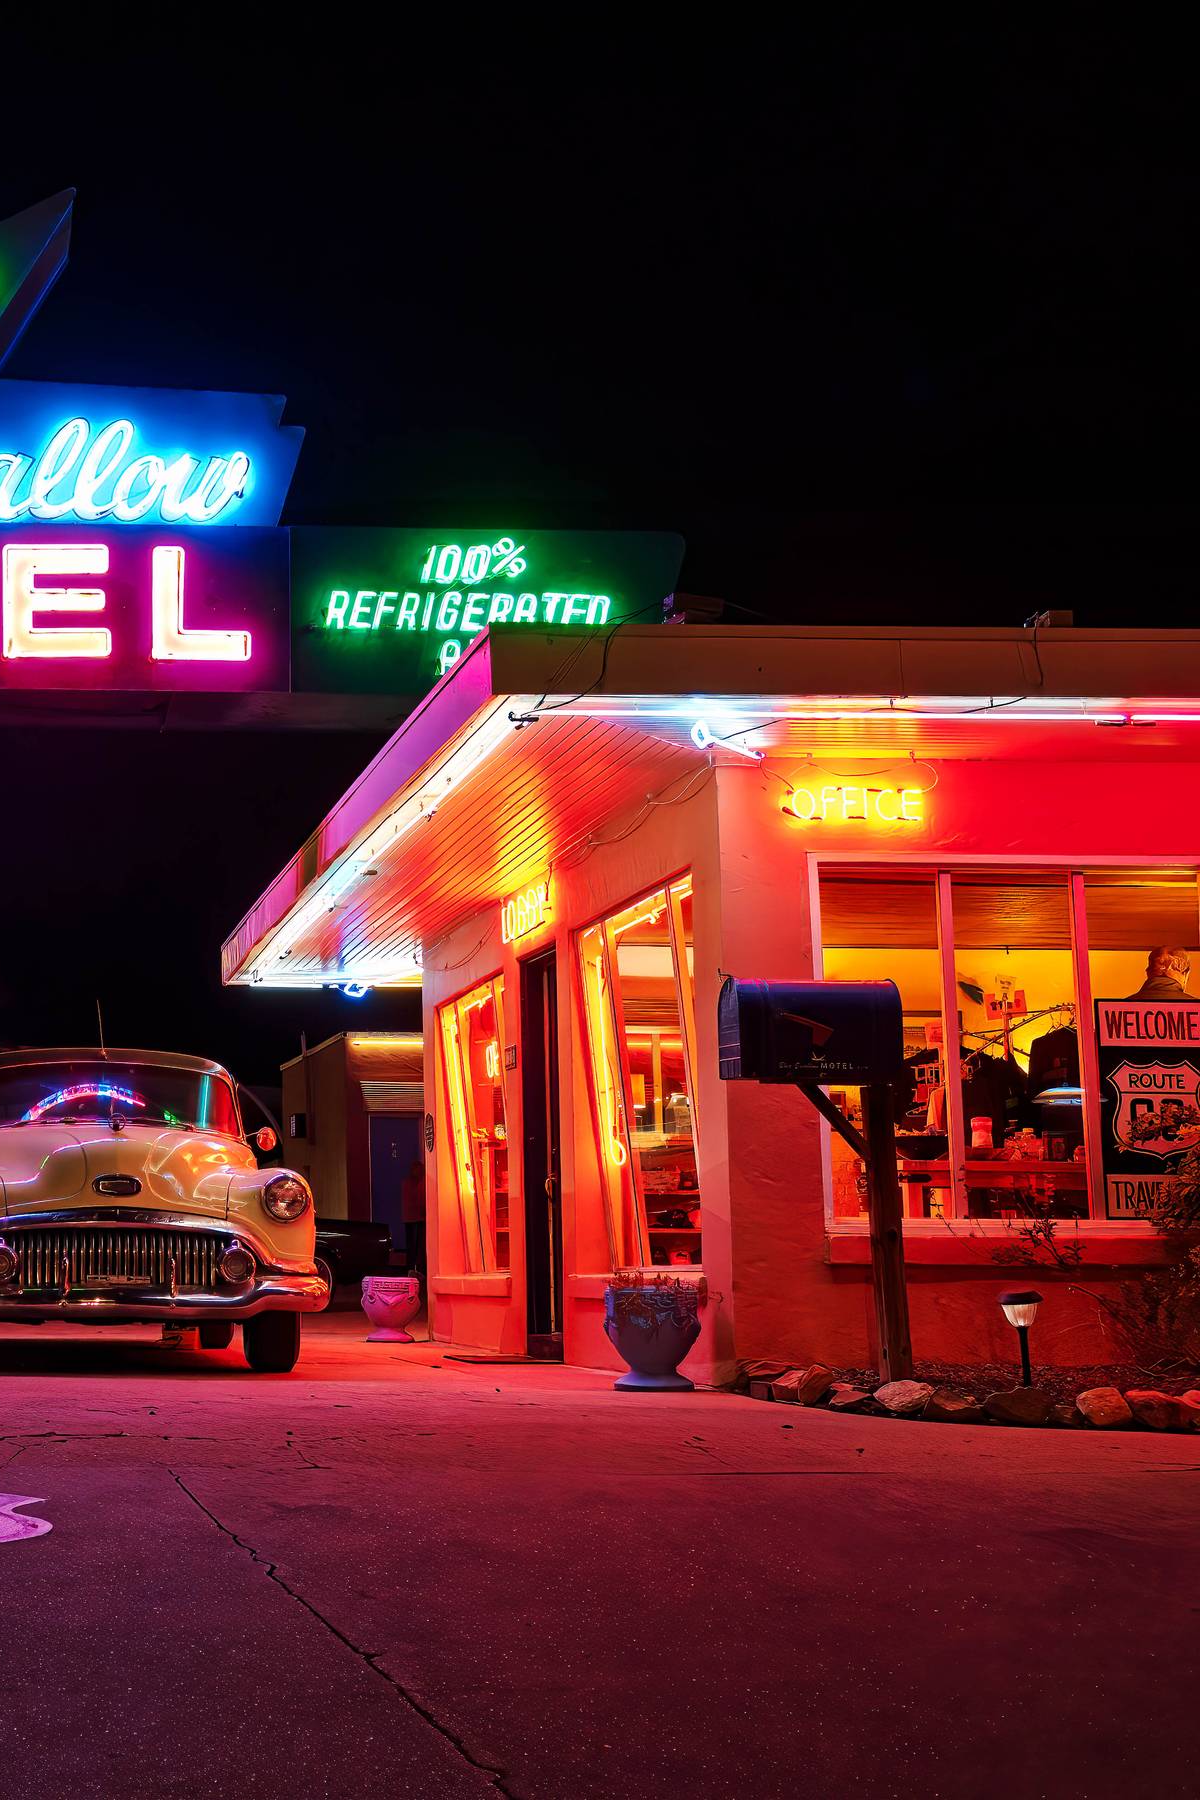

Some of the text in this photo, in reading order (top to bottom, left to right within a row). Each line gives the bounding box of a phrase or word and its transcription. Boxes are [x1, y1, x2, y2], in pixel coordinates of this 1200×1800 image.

[420, 537, 527, 584] 100%
[791, 786, 923, 821] OFFICE
[1104, 1010, 1200, 1041] WELCOME
[1128, 1073, 1186, 1090] ROUTE
